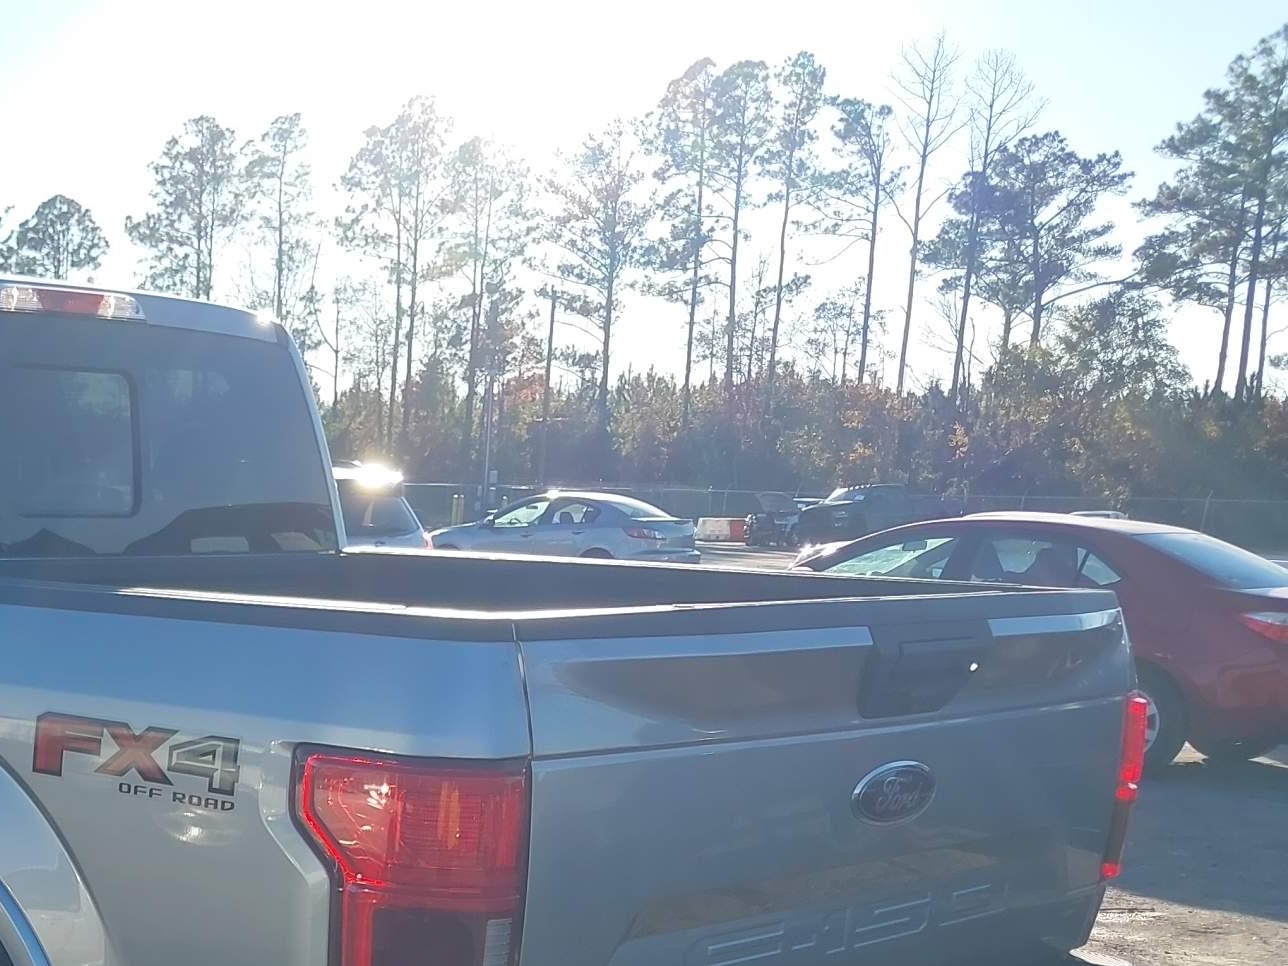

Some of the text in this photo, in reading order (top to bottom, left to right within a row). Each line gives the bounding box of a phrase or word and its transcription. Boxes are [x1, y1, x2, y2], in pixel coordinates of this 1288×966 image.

[32, 711, 241, 797] FX4
[118, 781, 236, 812] OFF ROAD
